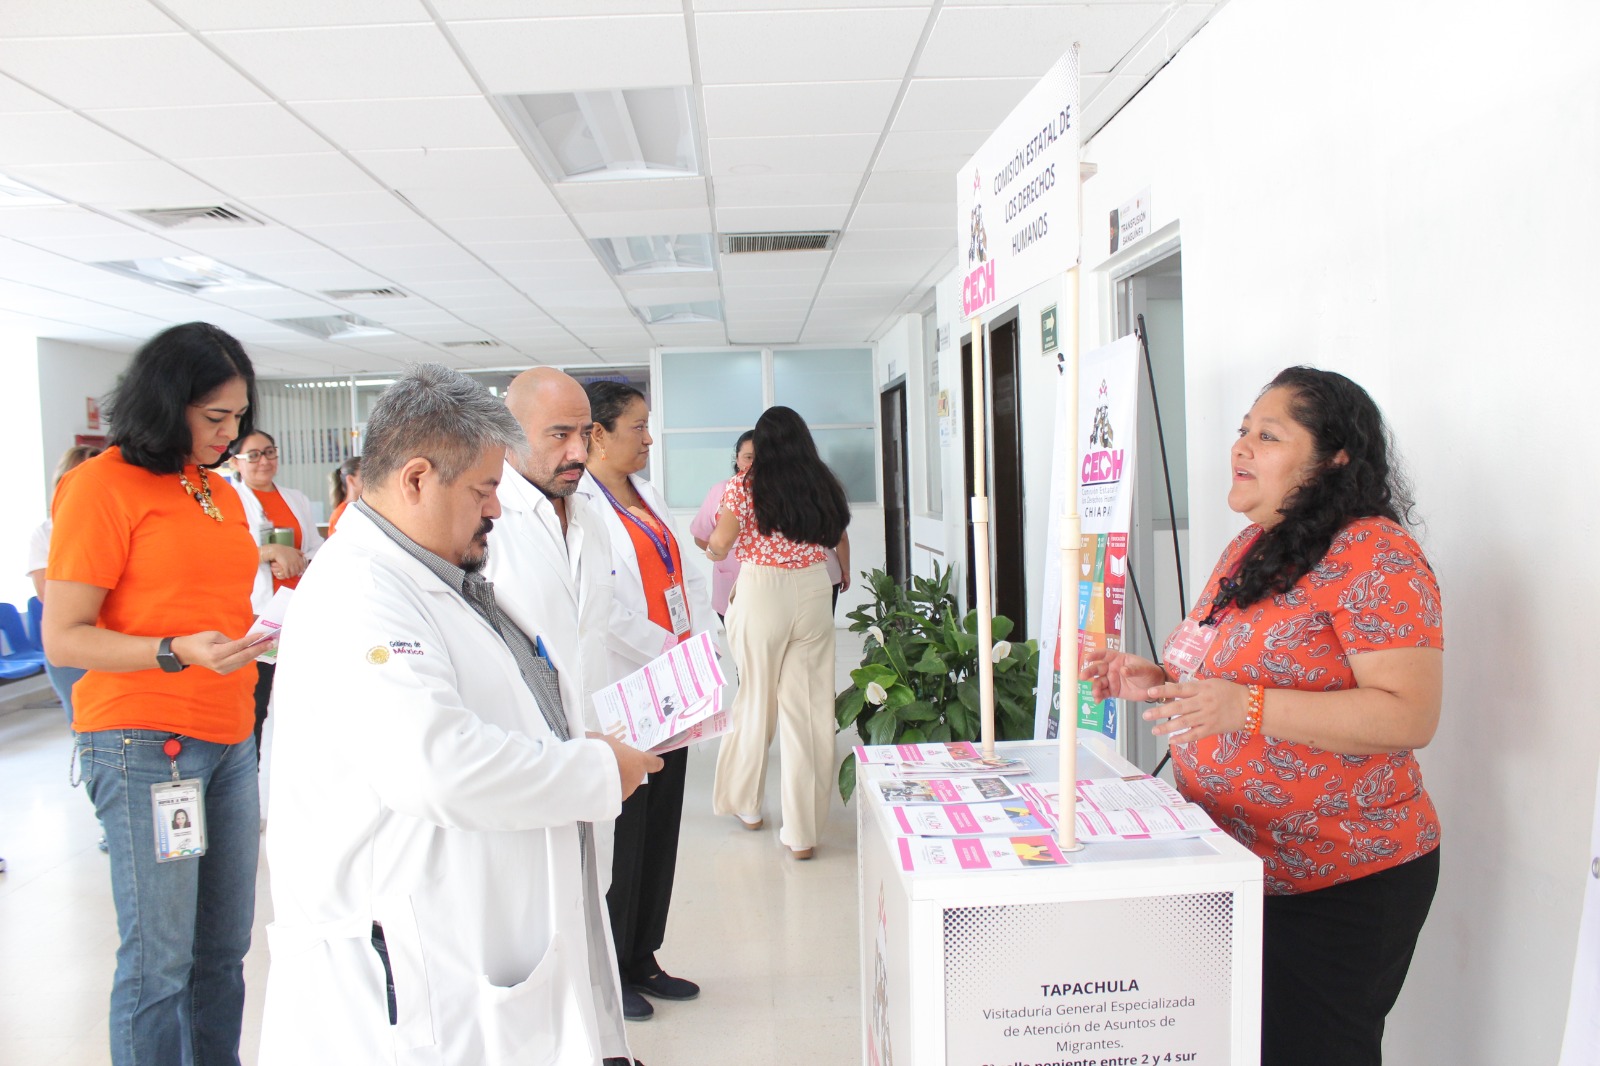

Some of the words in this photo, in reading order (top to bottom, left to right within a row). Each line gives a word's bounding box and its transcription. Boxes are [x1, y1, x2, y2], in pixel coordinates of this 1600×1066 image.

[994, 148, 1024, 196] COMISIÓN
[1026, 119, 1057, 166] ESTATAL
[1060, 104, 1070, 136] DE
[1005, 194, 1017, 224] LOS
[1018, 162, 1055, 214] DERECHOS
[1012, 212, 1048, 256] HUMANOS
[963, 258, 995, 316] CEDH
[1082, 449, 1124, 483] CEDH
[1106, 587, 1110, 598] 8
[389, 640, 412, 648] Gobierno
[393, 647, 424, 655] México
[1107, 638, 1113, 649] 12
[1040, 979, 1139, 997] TAPACHULA
[982, 1005, 1052, 1020] Visitaduría
[1056, 1001, 1107, 1016] General
[1111, 996, 1196, 1015] Especializada
[1004, 1026, 1020, 1037] de
[1023, 1021, 1080, 1036] Atención
[1084, 1021, 1100, 1032] de
[1104, 1017, 1156, 1031] Asuntos
[1160, 1016, 1176, 1027] de
[1056, 1039, 1124, 1054] Migrantes.
[1100, 1056, 1137, 1066] entre
[1142, 1054, 1149, 1064] 2
[1152, 1055, 1160, 1066] y
[1164, 1052, 1171, 1062] 4
[1175, 1052, 1197, 1062] sur
